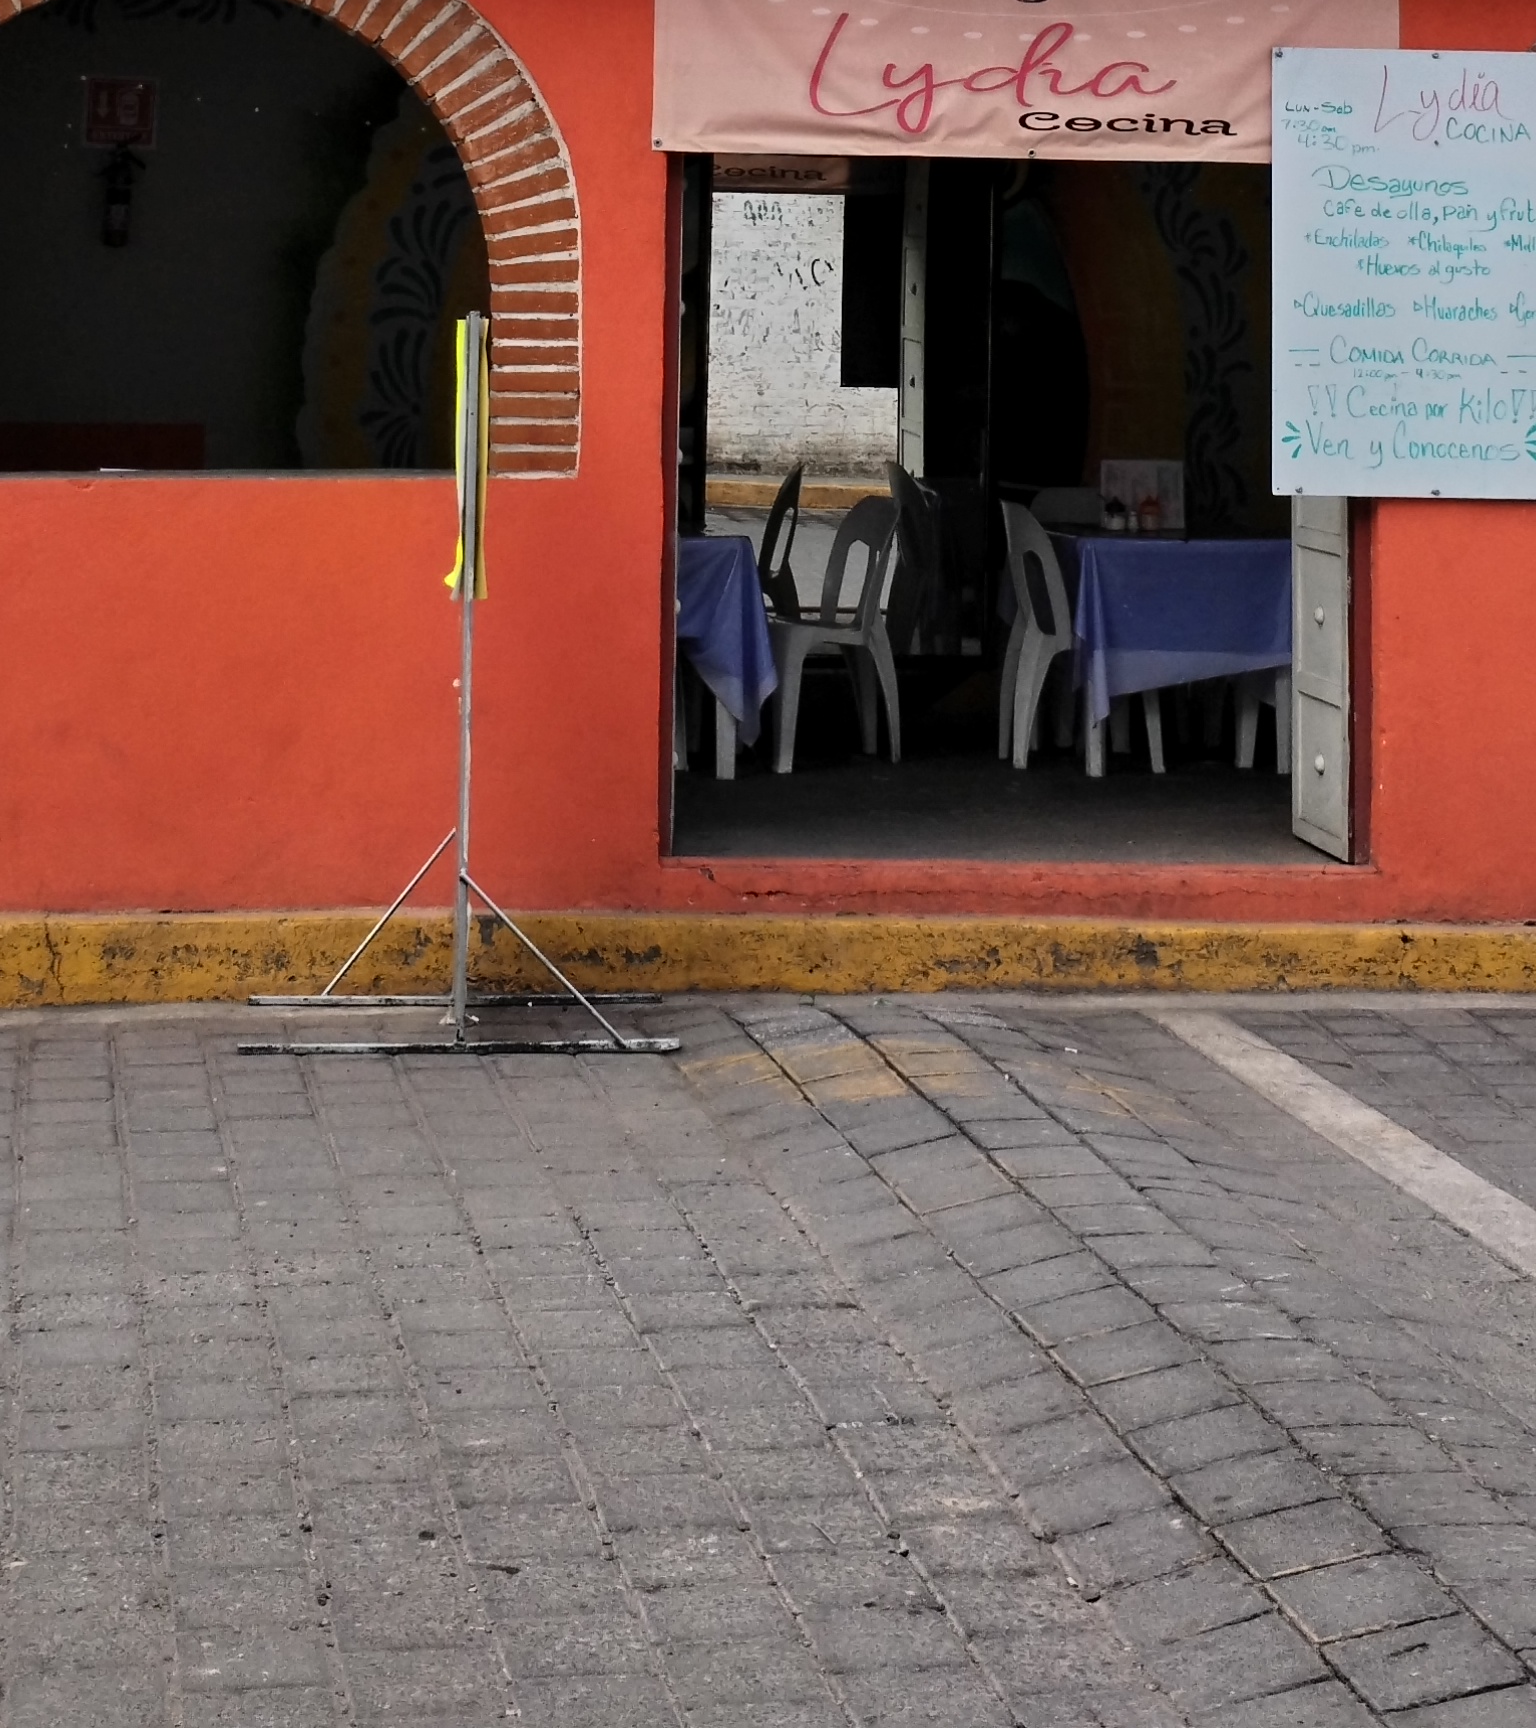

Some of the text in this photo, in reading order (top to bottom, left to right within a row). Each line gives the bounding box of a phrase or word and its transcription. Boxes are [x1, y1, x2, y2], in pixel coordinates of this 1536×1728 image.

[807, 11, 1178, 135] Lydia
[1373, 64, 1513, 142] Lydia
[1017, 110, 1238, 137] Cocina
[1446, 117, 1531, 144] COCINA
[1297, 134, 1345, 152] 4:30
[1312, 164, 1470, 198] Desayunos
[1370, 201, 1393, 219] de
[1366, 253, 1422, 276] Huevos
[1445, 258, 1492, 284] gusto
[1303, 291, 1397, 319] Quesadillas
[1305, 419, 1522, 469] Ven y Conocenos
